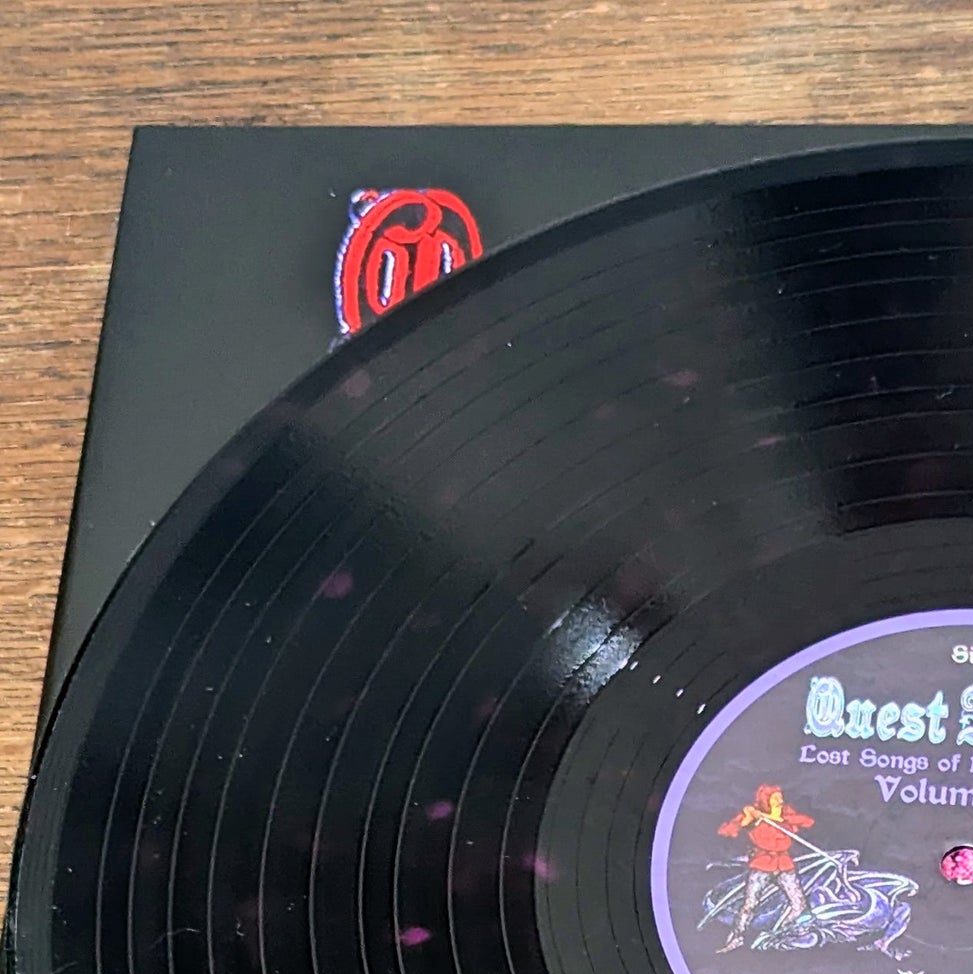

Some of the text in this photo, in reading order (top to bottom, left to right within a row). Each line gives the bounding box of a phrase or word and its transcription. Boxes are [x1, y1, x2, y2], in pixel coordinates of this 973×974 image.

[803, 675, 950, 744] Quest
[799, 744, 850, 766] Lost
[858, 747, 929, 775] Songs
[937, 753, 962, 774] of
